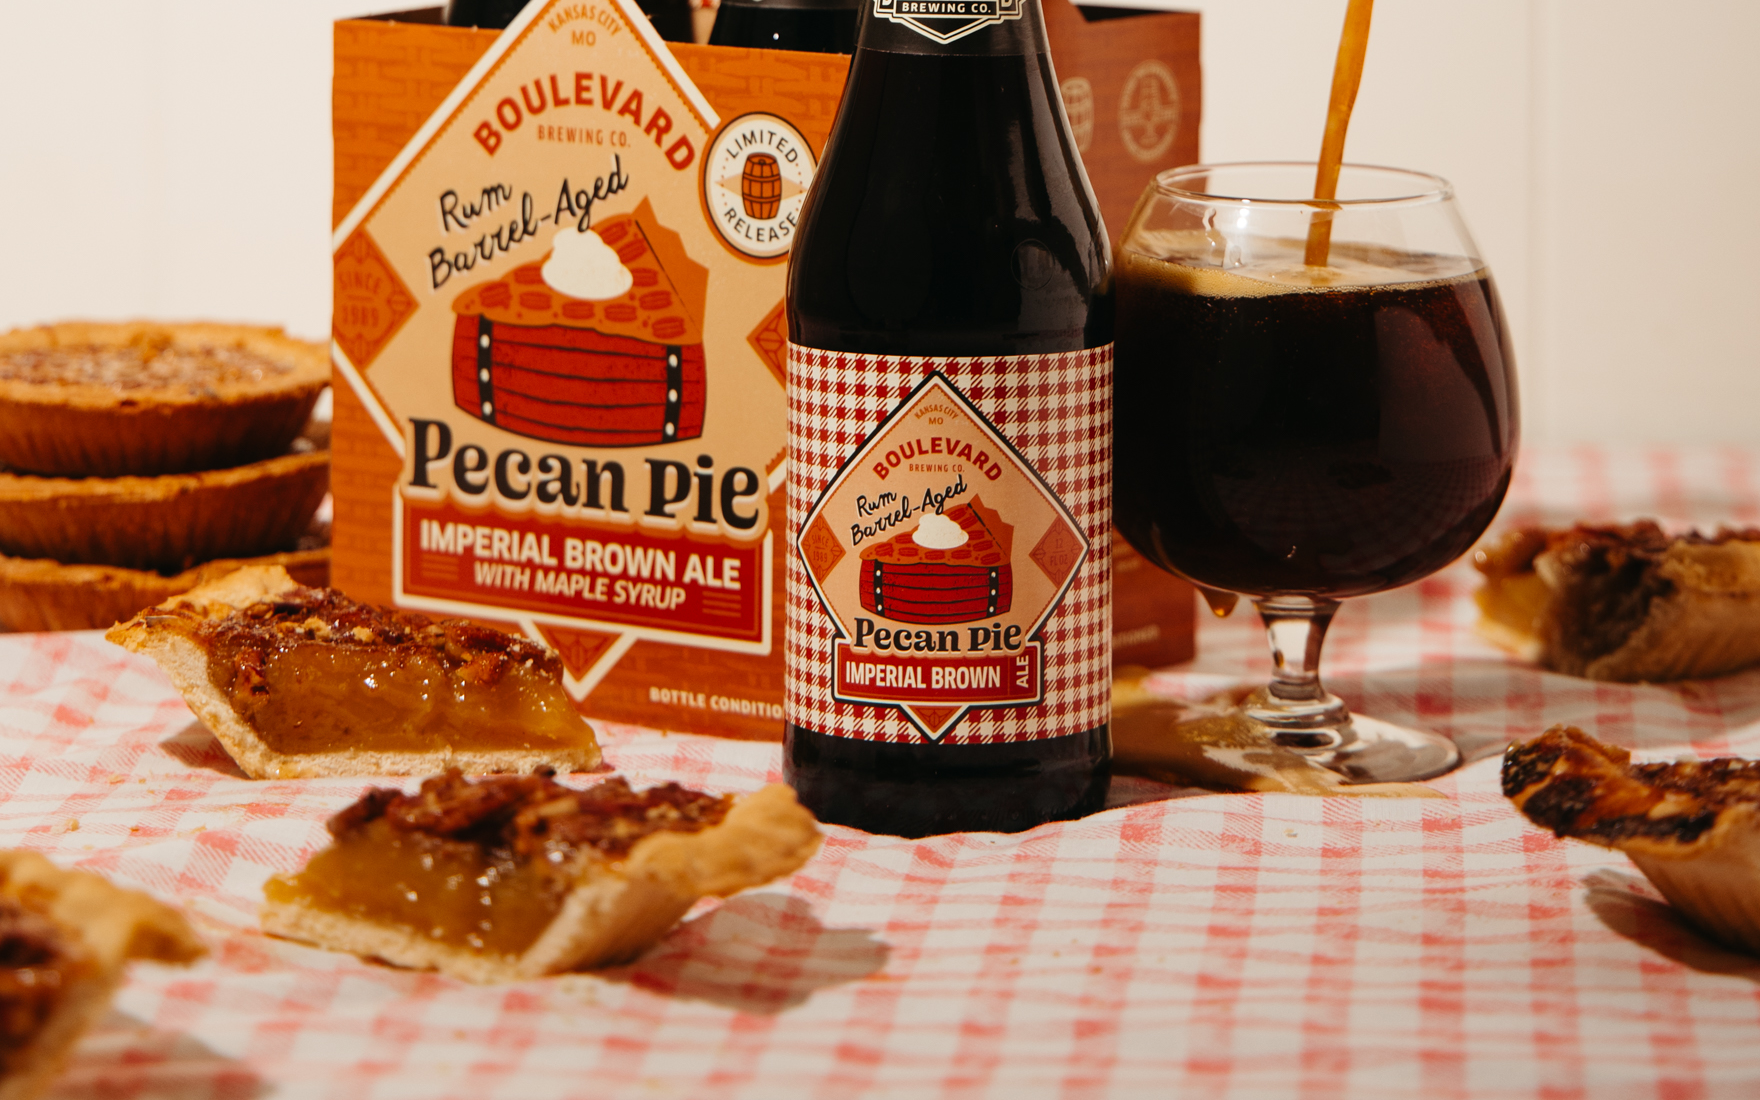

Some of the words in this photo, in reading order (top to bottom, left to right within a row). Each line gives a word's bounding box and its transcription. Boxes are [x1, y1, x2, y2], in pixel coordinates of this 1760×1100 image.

[548, 3, 597, 33] KANSAS
[597, 10, 622, 37] CITY
[902, 2, 965, 13] BREWING
[971, 3, 991, 14] CO.
[571, 30, 597, 46] MO
[473, 71, 696, 171] BOULEVARD
[537, 124, 604, 146] BREWING
[610, 130, 631, 148] CO.
[726, 129, 798, 163] LIMITED
[429, 153, 629, 289] Barrel-Aged
[440, 182, 513, 232] Rum
[724, 207, 797, 242] RELEASE
[338, 269, 382, 296] SINCE
[914, 404, 943, 419] KANSAS
[943, 406, 960, 419] CITY
[928, 417, 944, 425] MO
[408, 417, 630, 514] Pecan
[643, 453, 760, 530] Pie
[872, 436, 1003, 481] BOULEVARD
[909, 463, 949, 473] BREWING
[952, 464, 965, 473] CO.
[850, 473, 968, 546] Barrel-Aged
[856, 491, 897, 518] Rum
[419, 518, 558, 567] IMPERIAL
[564, 537, 676, 582] BROWN
[682, 553, 742, 590] ALE
[474, 560, 531, 591] WITH
[533, 570, 610, 602] MAPLE
[611, 579, 687, 610] SYRUP
[853, 617, 961, 652] Pecan
[967, 622, 1021, 651] Pie
[845, 661, 926, 689] IMPERIAL
[931, 665, 1000, 689] BROWN
[1016, 654, 1029, 688] ALE
[649, 686, 706, 709] BOTTLE
